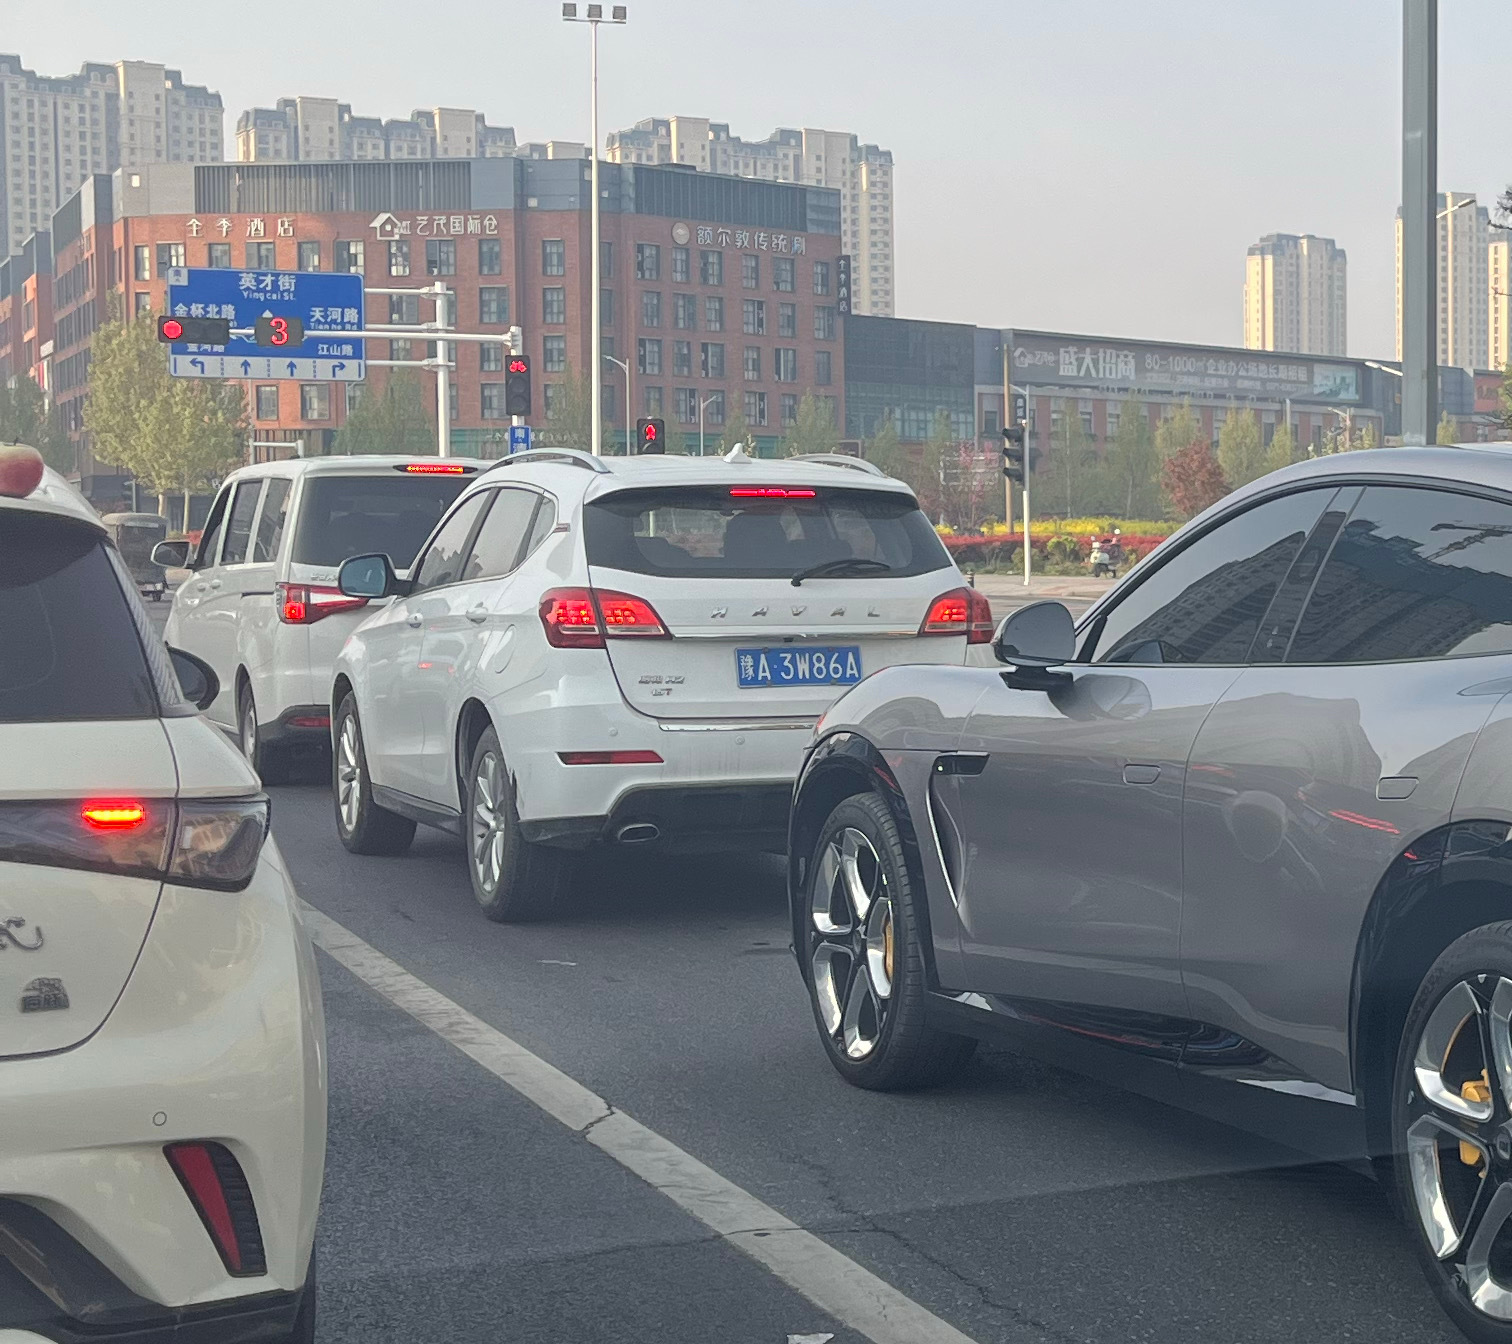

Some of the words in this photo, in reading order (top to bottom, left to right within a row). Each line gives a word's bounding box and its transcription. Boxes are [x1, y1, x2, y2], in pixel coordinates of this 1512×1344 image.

[186, 217, 295, 237] 全季酒店
[696, 225, 806, 256] 额尔敦传统涮
[239, 273, 296, 291] 英才街
[174, 303, 236, 319] 金杯北路
[310, 307, 358, 323] 天河路
[270, 317, 288, 345] 3
[318, 344, 353, 356] 江山路
[1059, 346, 1135, 380] 盛大招商
[711, 606, 880, 618] HAVAL
